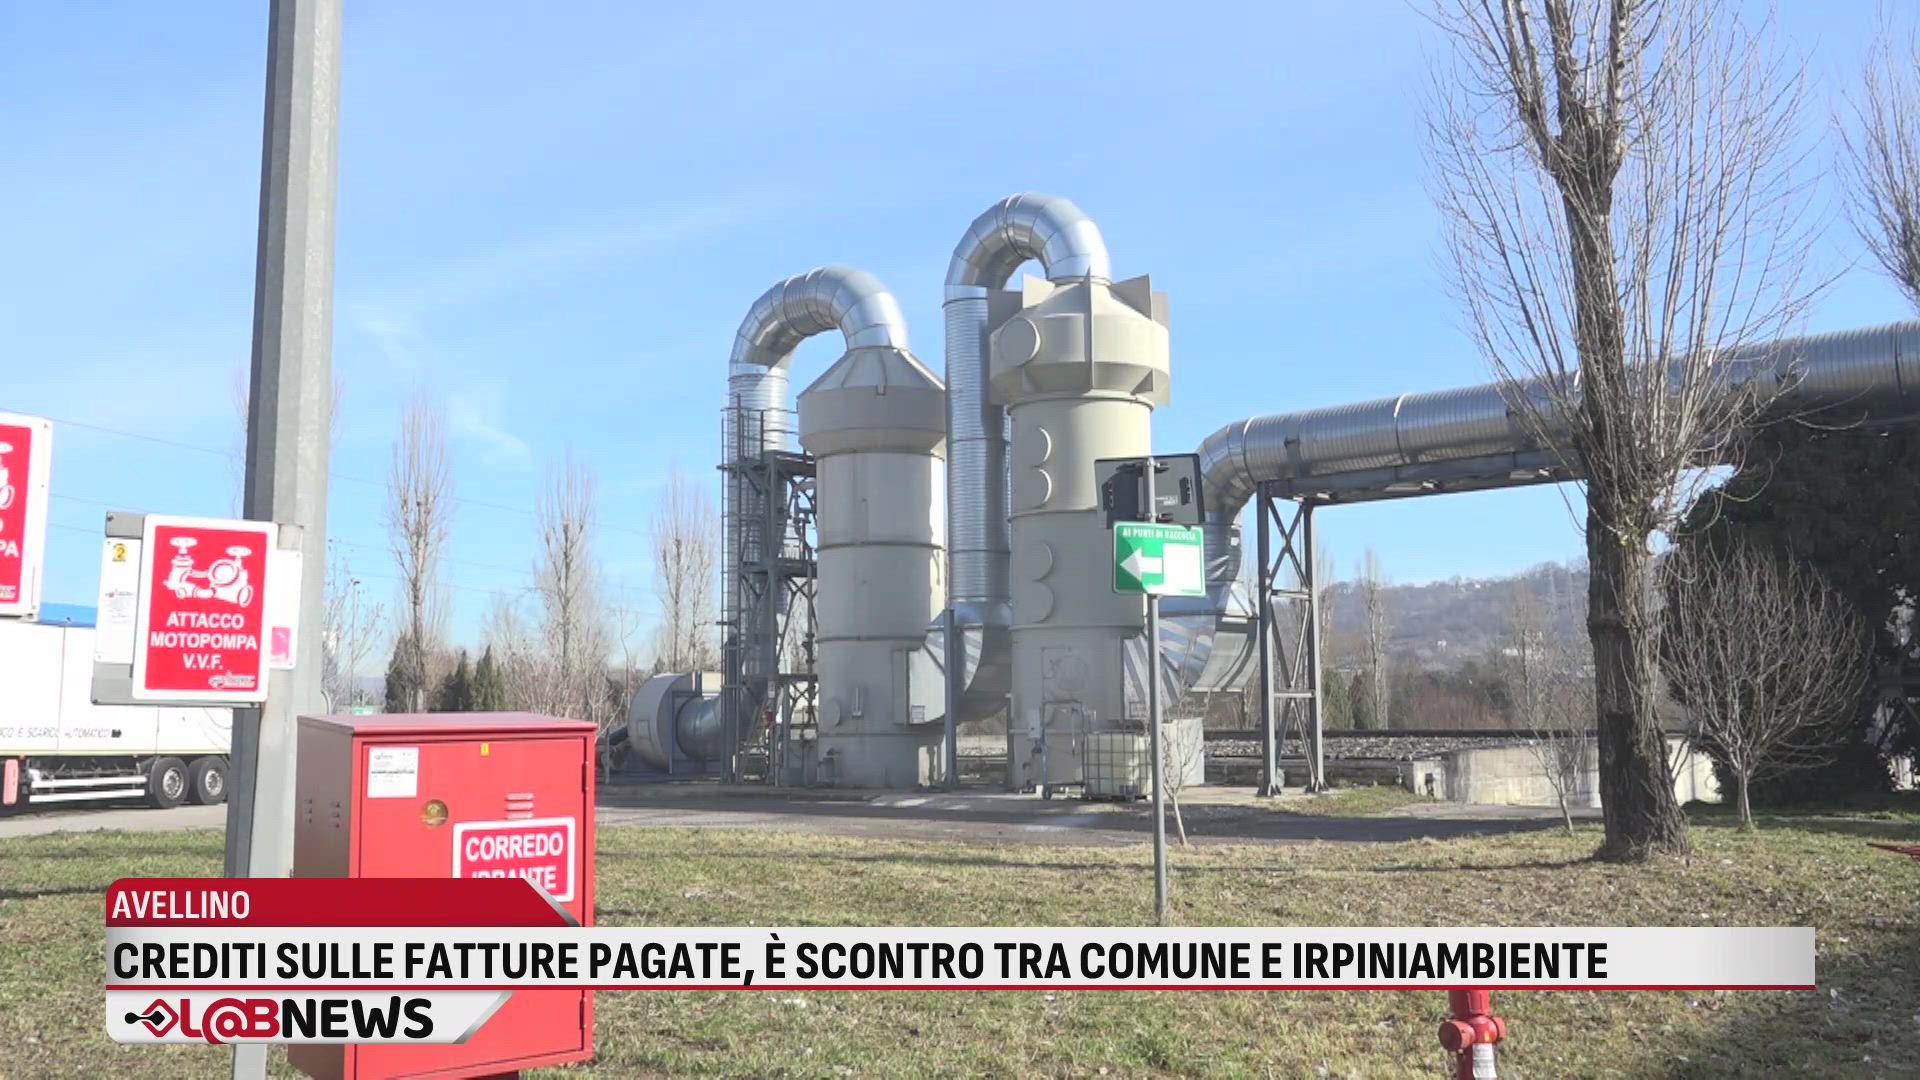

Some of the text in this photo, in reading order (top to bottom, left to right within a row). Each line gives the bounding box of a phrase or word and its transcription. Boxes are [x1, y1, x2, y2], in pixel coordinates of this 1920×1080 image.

[166, 611, 245, 629] ATTACCO
[150, 631, 258, 650] MOTOPOMPA
[182, 653, 223, 670] V.V.F.
[465, 832, 564, 862] CORREDO
